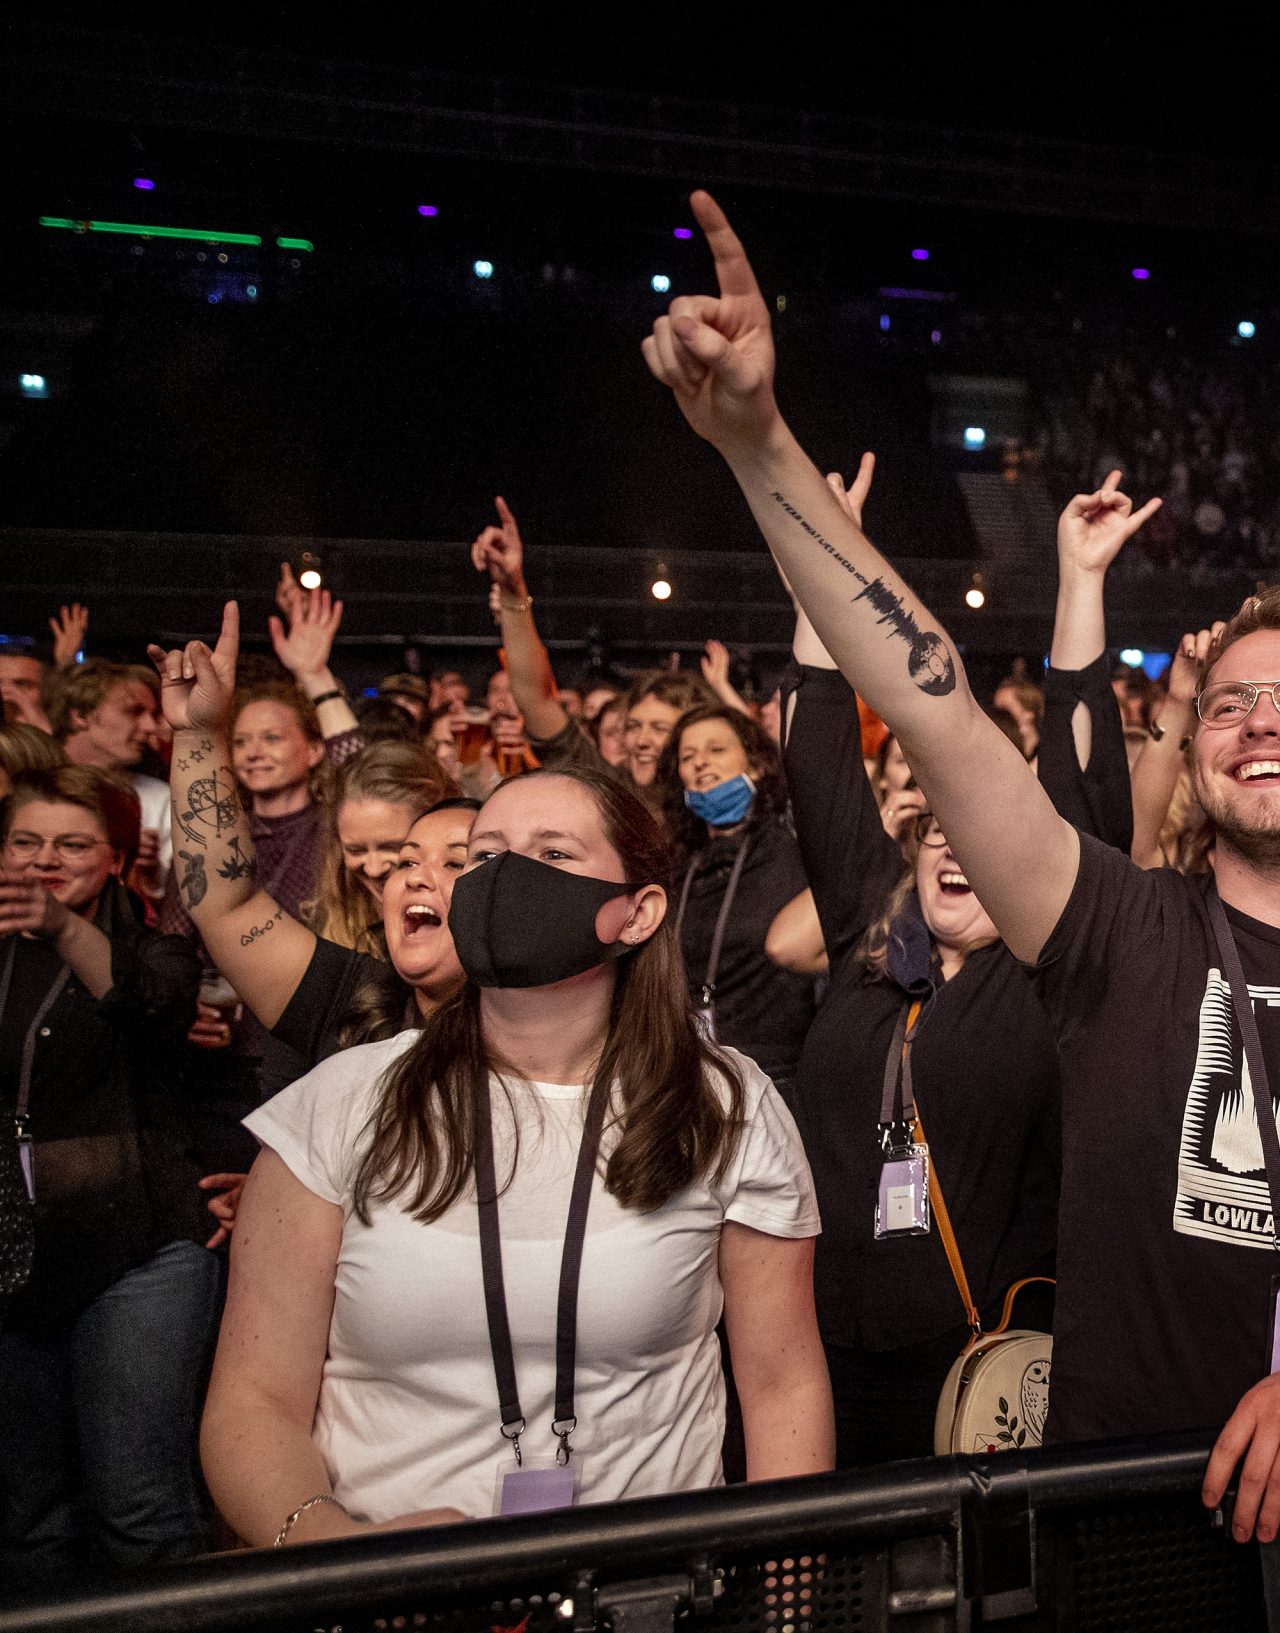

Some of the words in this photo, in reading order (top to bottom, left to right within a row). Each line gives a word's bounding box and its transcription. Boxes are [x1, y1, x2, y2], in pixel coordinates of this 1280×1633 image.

[782, 503, 802, 521] FEAR
[800, 520, 821, 538] WHAT
[818, 538, 836, 553] LIES
[833, 552, 855, 573] AHEAD
